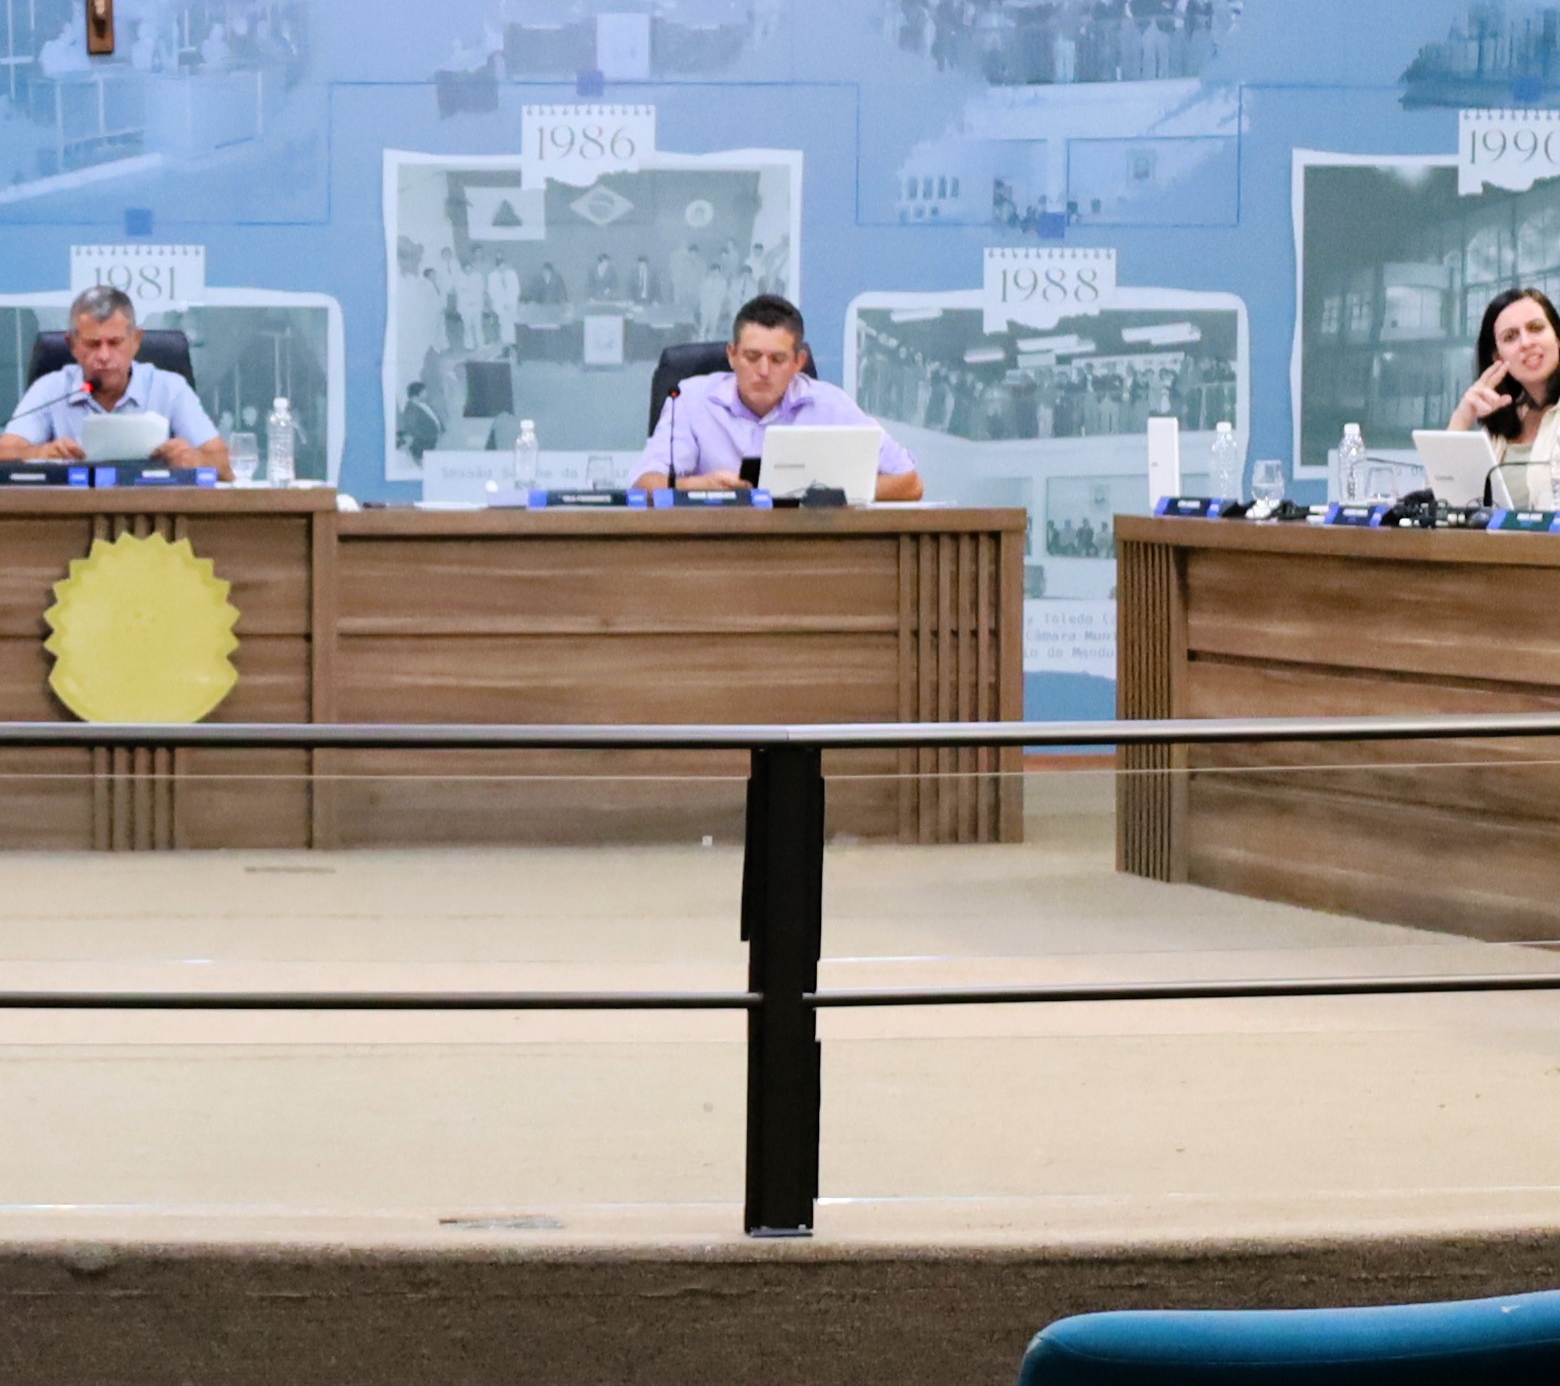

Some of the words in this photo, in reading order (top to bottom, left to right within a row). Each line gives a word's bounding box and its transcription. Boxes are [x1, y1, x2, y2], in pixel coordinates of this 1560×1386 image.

[536, 124, 637, 161] 1986
[95, 264, 176, 301] 1981
[999, 266, 1100, 303] 1988
